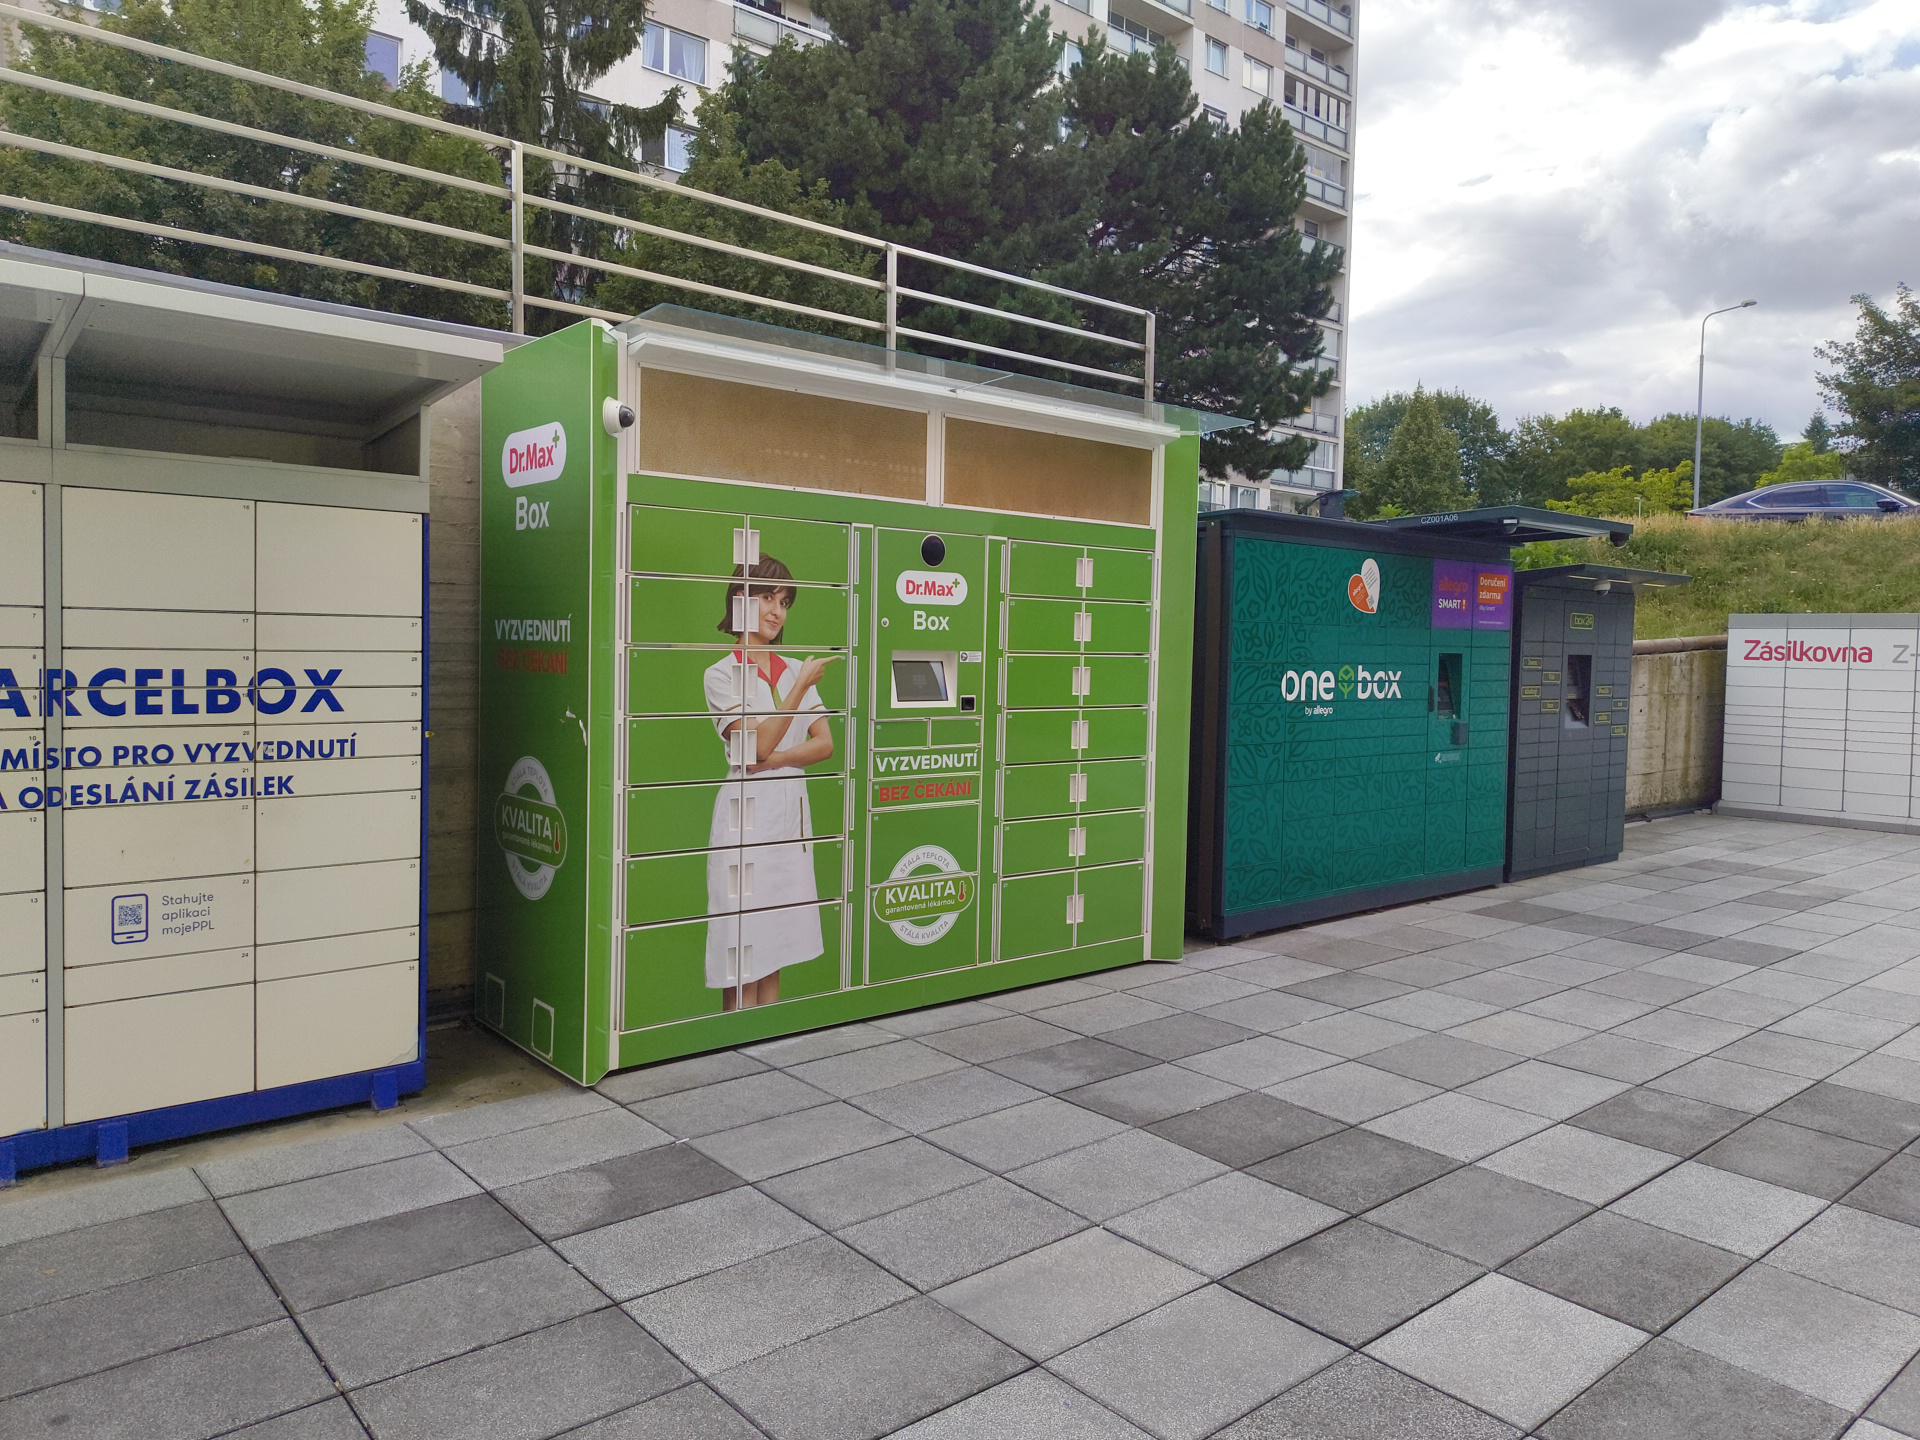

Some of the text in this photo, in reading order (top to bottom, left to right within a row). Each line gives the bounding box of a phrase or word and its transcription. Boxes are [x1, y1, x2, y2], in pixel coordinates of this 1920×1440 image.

[509, 443, 554, 474] Dr.Max
[515, 496, 550, 531] Box
[905, 579, 954, 597] Dr.Max
[495, 613, 572, 643] VYZVEDNUTÍ
[913, 611, 950, 631] Box
[1743, 639, 1873, 664] Zásilkovna
[1281, 665, 1402, 701] one box
[0, 733, 358, 770] MÍSTO PRO VYZVEDNUTÍ
[876, 749, 979, 772] VYZVEDNUTÍ
[18, 774, 175, 809] ODESLÁNÍ
[184, 772, 295, 800] ZÁSILEK
[879, 779, 972, 803] BEZ ČEKÁNÍ
[501, 804, 553, 841] KVALITA
[161, 893, 214, 909] Stahujte
[885, 880, 956, 905] KVALITA
[161, 907, 211, 922] aplikaci
[161, 920, 215, 937] mojePPL
